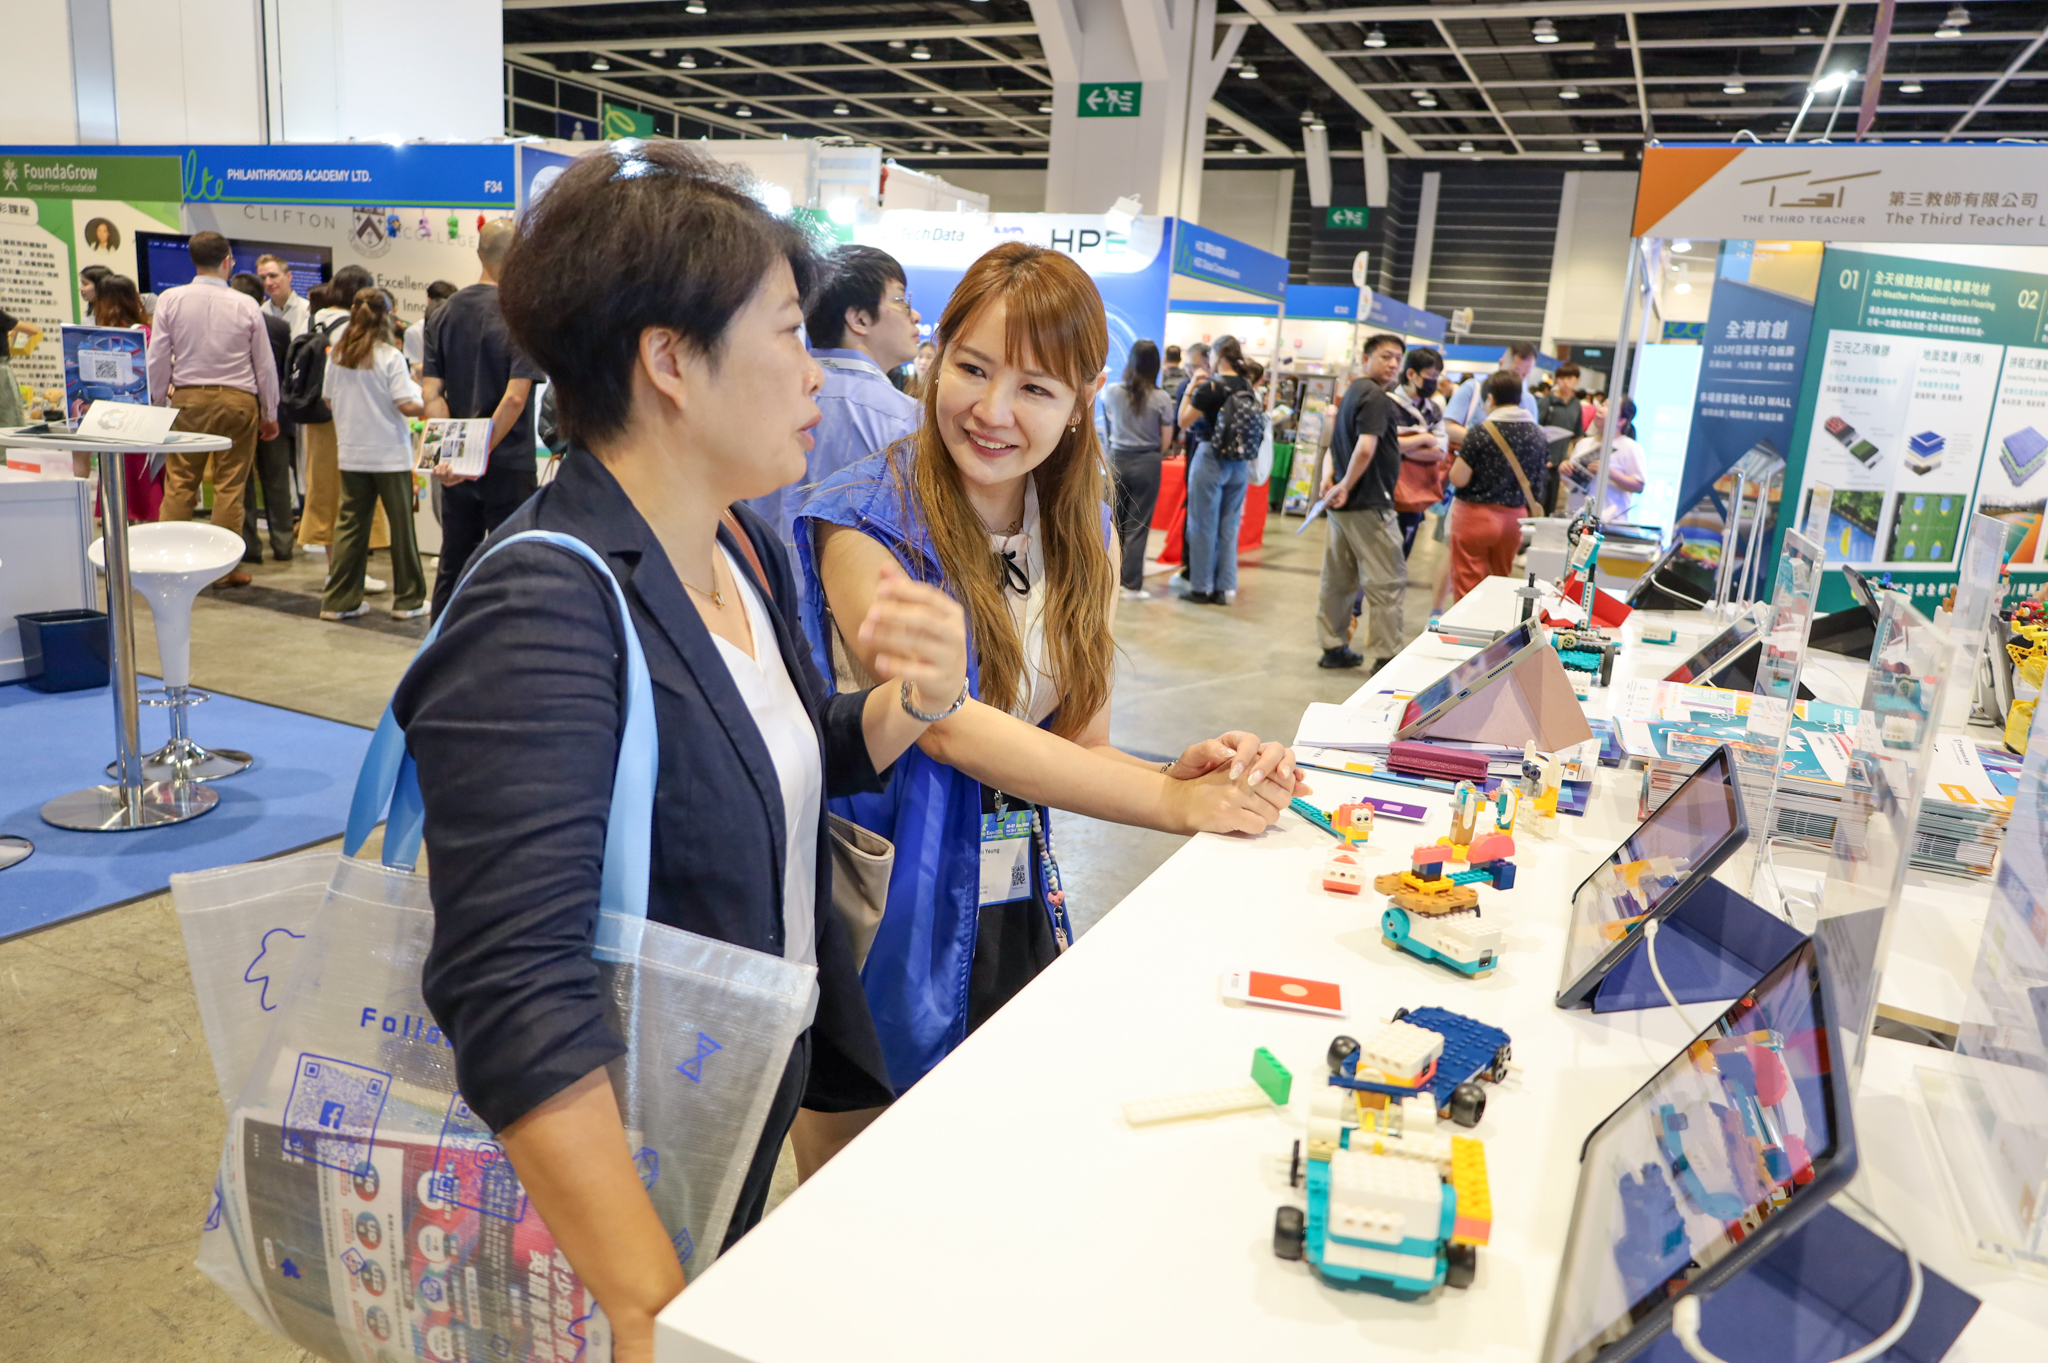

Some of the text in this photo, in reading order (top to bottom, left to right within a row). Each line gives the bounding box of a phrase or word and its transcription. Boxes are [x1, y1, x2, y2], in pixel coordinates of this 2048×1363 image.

[24, 163, 98, 181] FoundaGrow
[227, 168, 372, 182] PHILANTHROKIDS ACADEMY LTD.
[27, 182, 97, 193] Grow From Foundation
[484, 180, 503, 193] F34
[1888, 191, 2039, 208] 第三教師有限公司
[243, 204, 336, 229] CLIFTON
[1742, 214, 1866, 225] THE THIRD TEACHER
[1885, 212, 1914, 225] The
[1919, 213, 1963, 226] Third
[1968, 213, 2033, 227] Teacher
[932, 228, 965, 242] Data
[1051, 229, 1128, 254] HPE
[1839, 269, 1860, 290] 01
[2017, 289, 2040, 310] 02
[1725, 320, 1788, 340] 全港首創
[1748, 395, 1767, 406] LED
[1767, 397, 1792, 408] WALL
[360, 1007, 452, 1048] Follo
